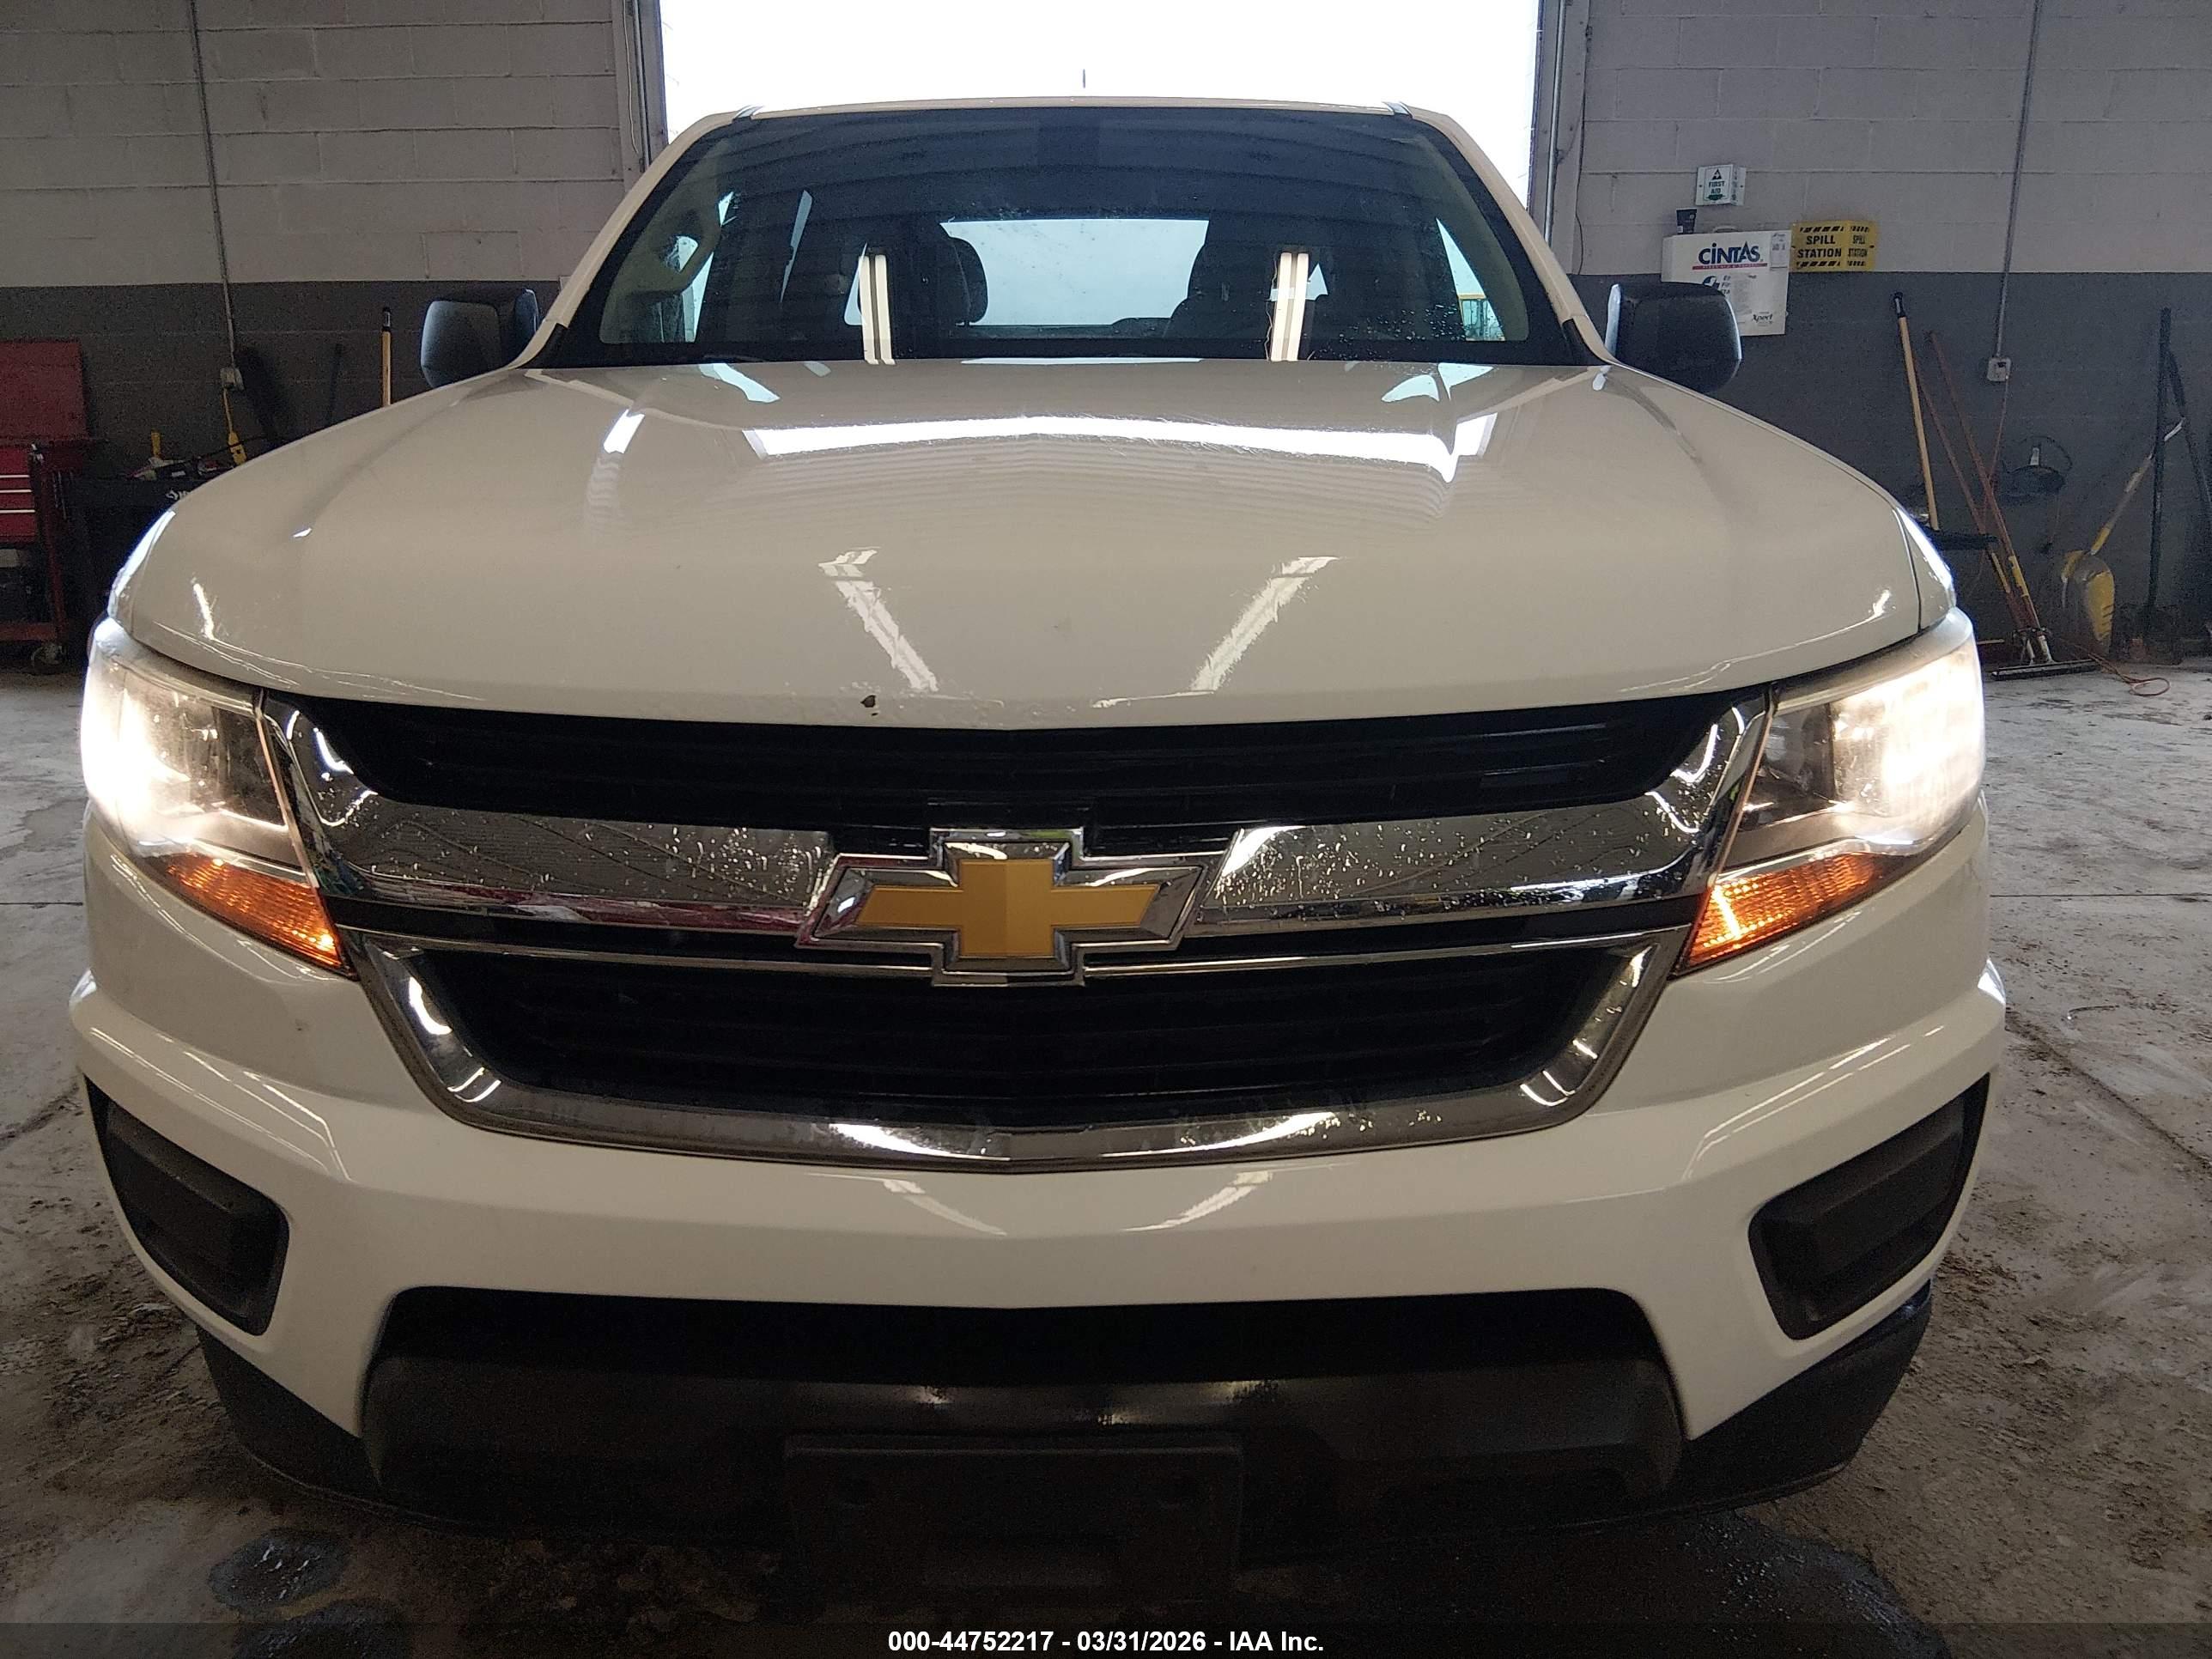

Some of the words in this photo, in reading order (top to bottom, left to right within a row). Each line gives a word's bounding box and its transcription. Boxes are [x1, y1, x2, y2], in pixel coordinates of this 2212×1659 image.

[1806, 234, 1836, 245] SPILL
[1852, 234, 1866, 245] SPILL
[1797, 248, 1842, 258] STATION
